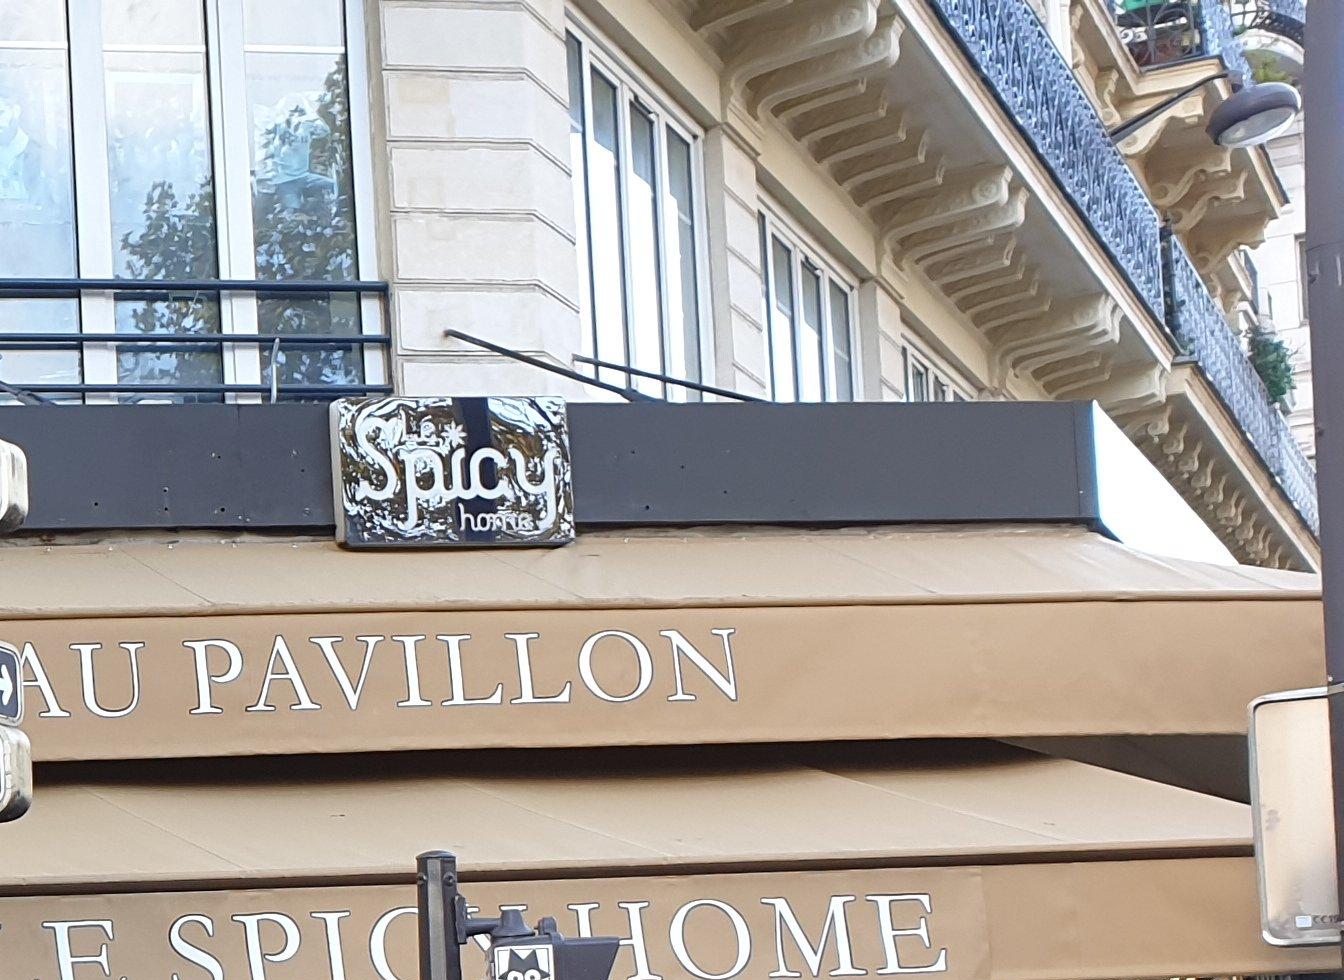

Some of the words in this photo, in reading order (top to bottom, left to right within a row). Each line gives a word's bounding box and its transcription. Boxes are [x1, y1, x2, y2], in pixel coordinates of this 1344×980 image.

[354, 415, 559, 531] Spicy
[458, 503, 534, 532] home
[19, 641, 146, 719] AU
[182, 627, 739, 715] PAVILLON
